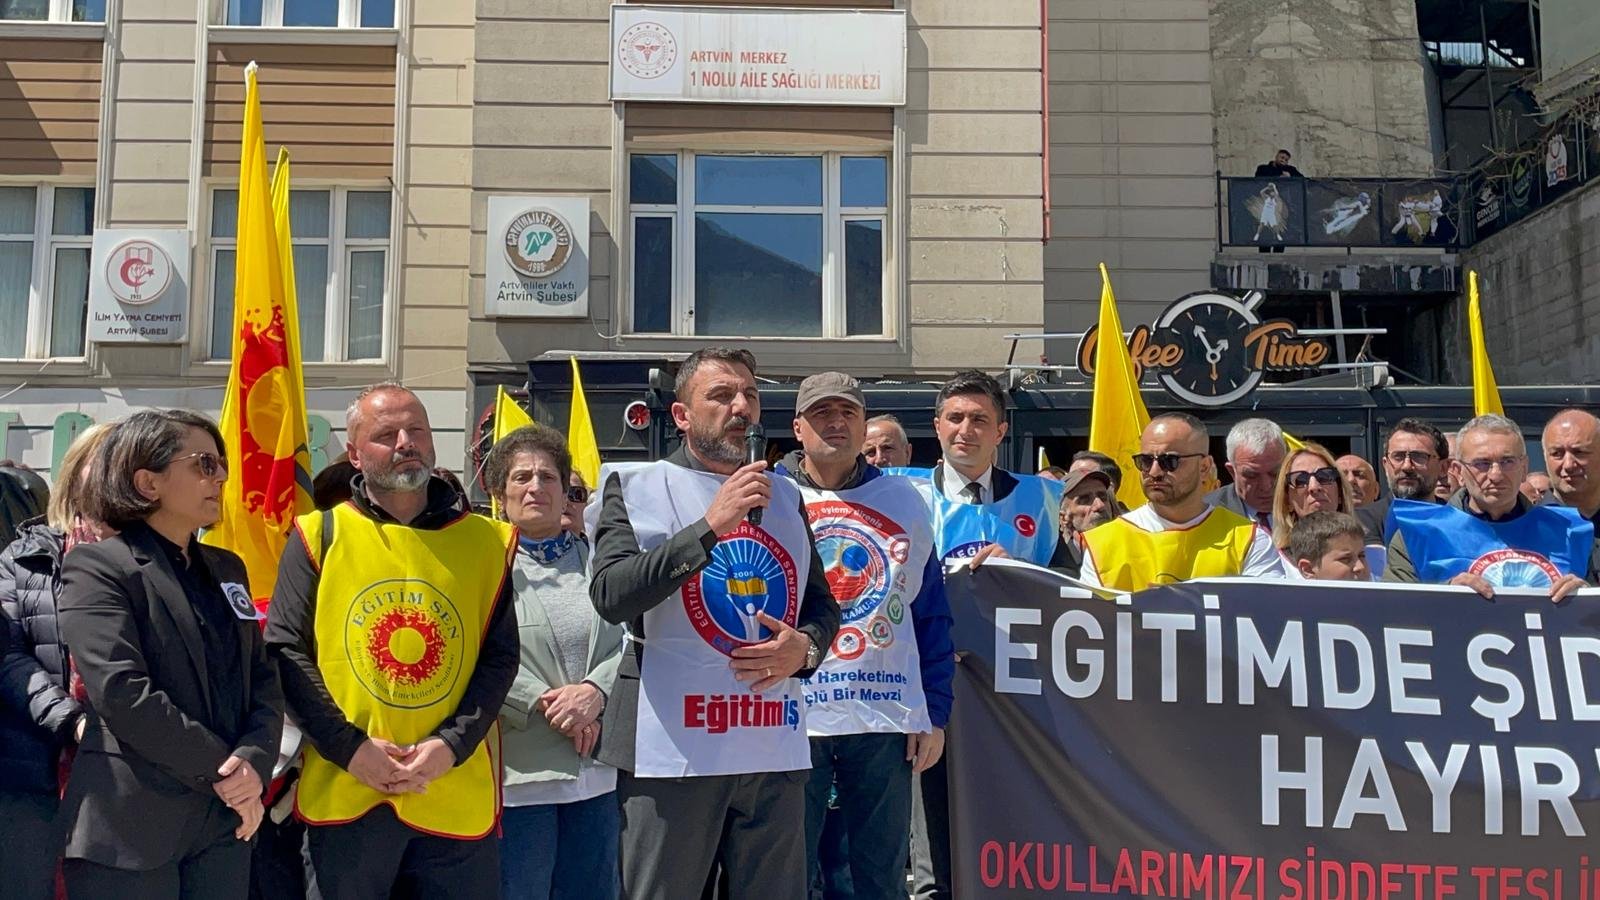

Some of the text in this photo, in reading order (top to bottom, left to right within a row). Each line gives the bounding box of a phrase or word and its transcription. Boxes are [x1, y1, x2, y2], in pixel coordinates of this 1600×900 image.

[690, 49, 788, 64] ARTVİN MERKEZ
[691, 68, 881, 90] 1 NOLU AİLE SAĞLIĞI MERKEZİ
[497, 290, 577, 303] Artvin Şubesi
[499, 281, 575, 290] Artvinliler Vakfı
[1244, 318, 1328, 371] Time
[352, 588, 460, 640] EĞİTİM SEN
[994, 586, 1442, 717] EĞİTİMDE
[817, 669, 907, 685] Hareketinde
[804, 688, 902, 707] çlü Bir Mevzi
[1260, 733, 1600, 837] HAYIR
[979, 840, 1266, 900] OKULLARIMIZI
